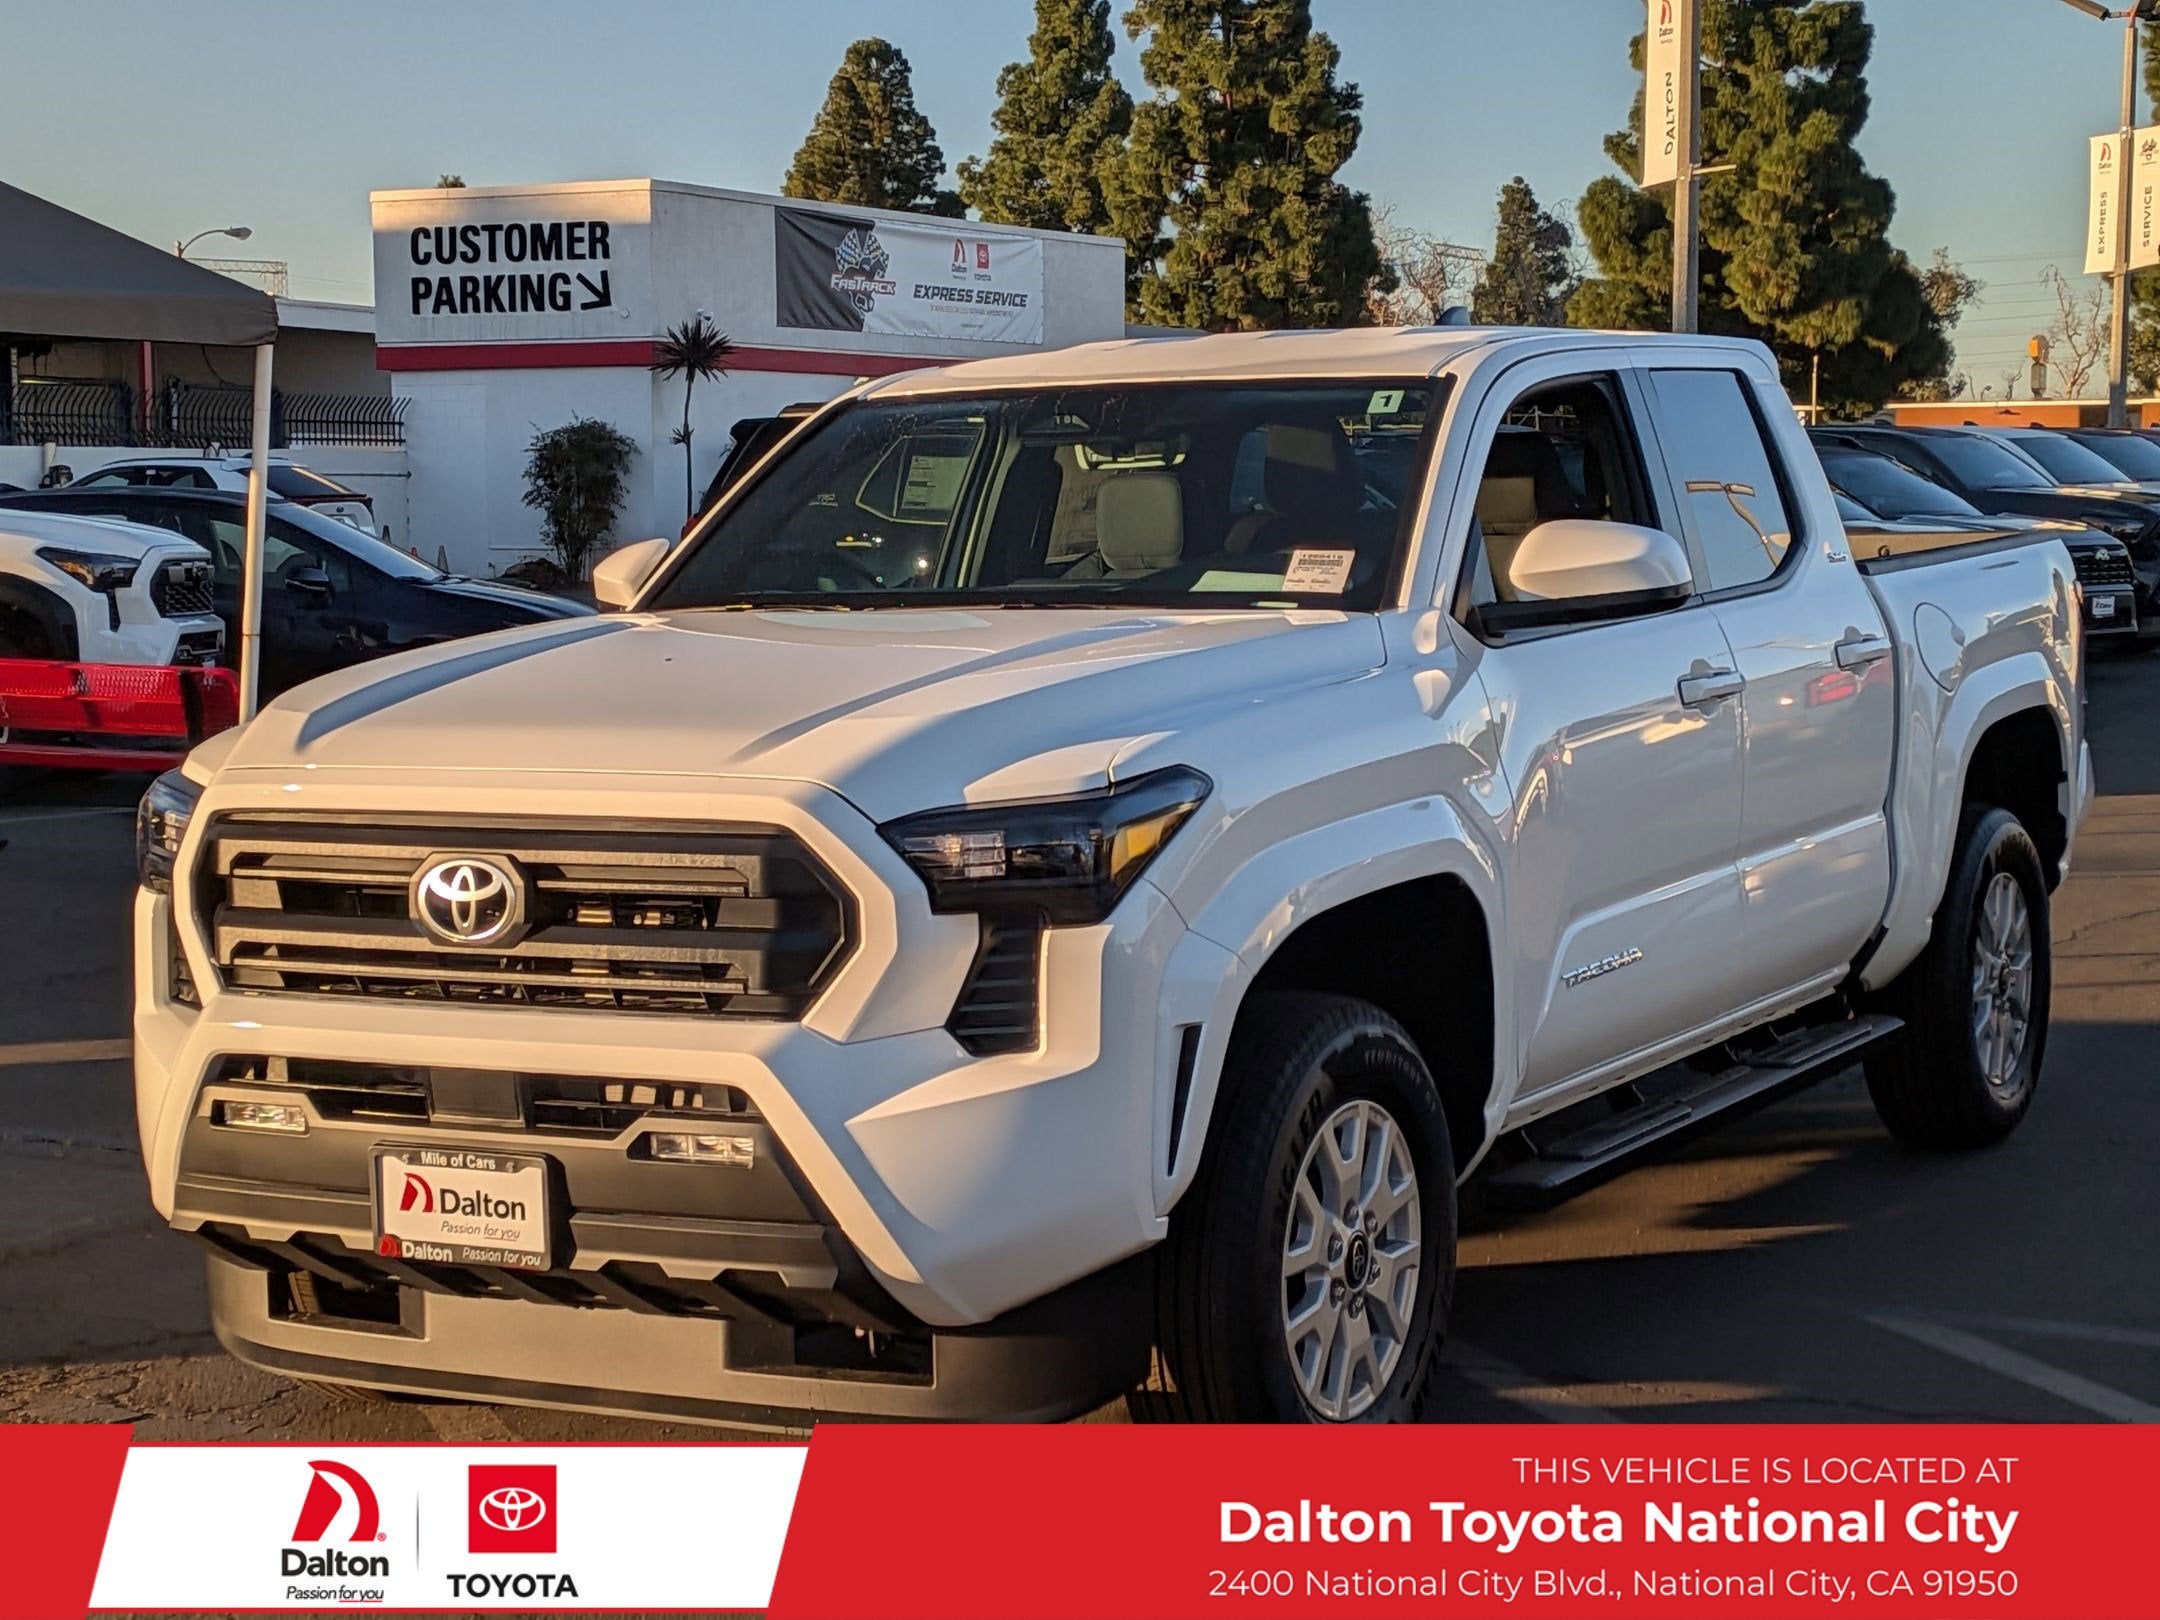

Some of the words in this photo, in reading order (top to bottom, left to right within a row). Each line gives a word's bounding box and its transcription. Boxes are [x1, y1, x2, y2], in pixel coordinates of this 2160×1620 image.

[1664, 71, 1676, 156] DALTON
[2097, 191, 2108, 255] EXPRESS
[2142, 185, 2153, 248] SERVICE
[411, 221, 611, 265] CUSTOMER
[411, 272, 572, 315] PARKING
[913, 283, 974, 303] EXPRESS
[975, 289, 1028, 308] SERVICE
[1380, 394, 1393, 408] 1
[421, 1151, 447, 1166] Mile
[450, 1154, 465, 1168] of
[466, 1155, 496, 1170] Cars
[440, 1188, 526, 1221] Dalton
[441, 1220, 481, 1235] Passion
[483, 1223, 500, 1238] for
[501, 1227, 521, 1240] you
[402, 1241, 453, 1262] Dalton
[462, 1246, 502, 1261] Passion
[503, 1251, 520, 1264] for
[521, 1254, 542, 1267] you
